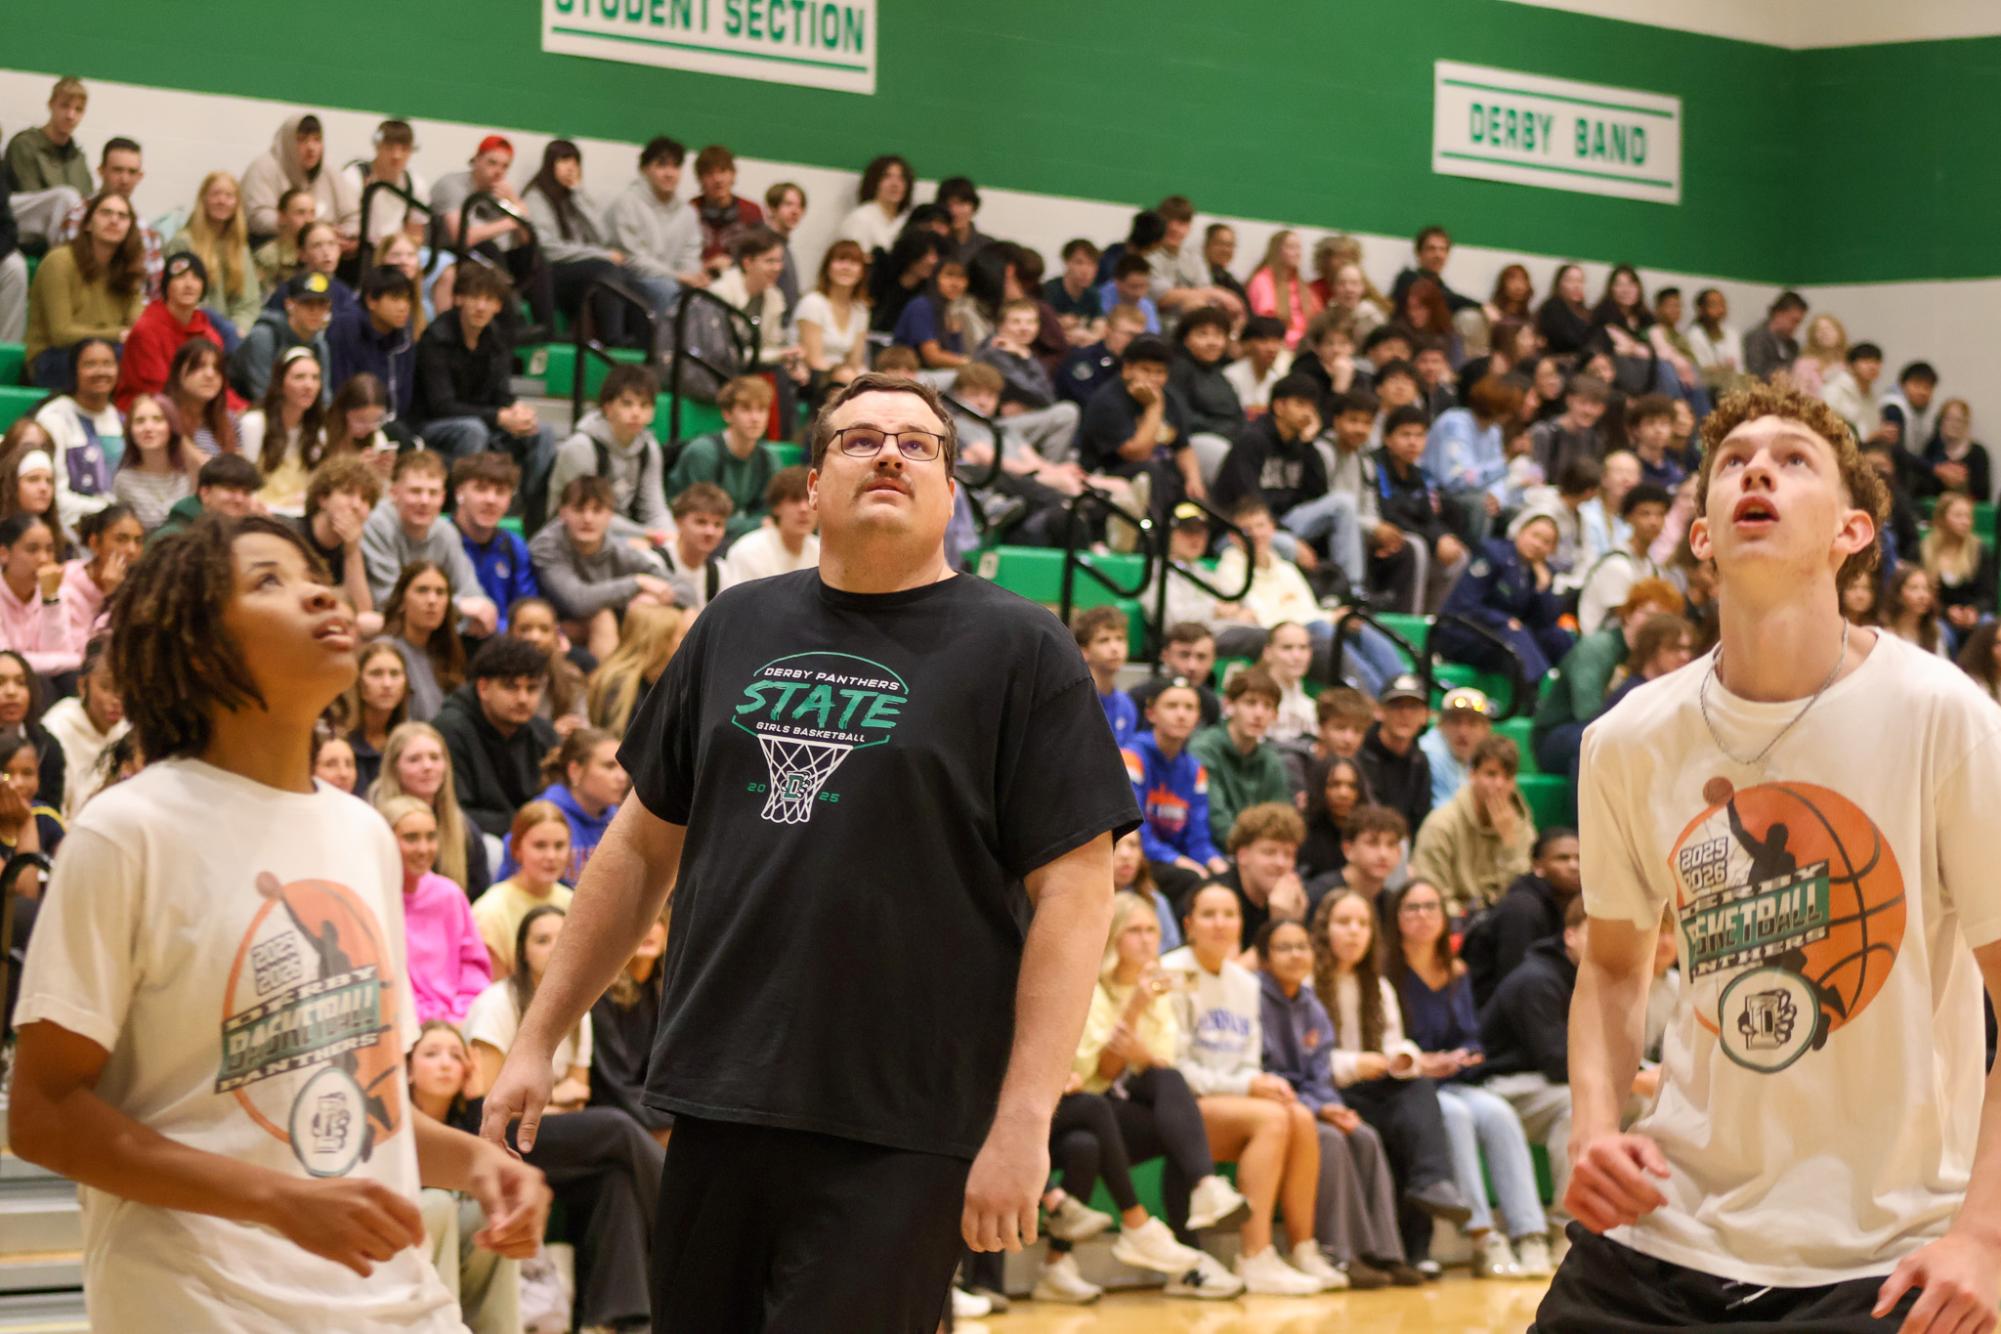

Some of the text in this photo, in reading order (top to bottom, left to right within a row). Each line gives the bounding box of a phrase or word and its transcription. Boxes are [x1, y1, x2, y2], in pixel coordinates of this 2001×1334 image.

[722, 0, 865, 53] SECTION
[1470, 102, 1647, 166] DERBY BAND
[764, 667, 900, 691] DERBY PANTHERS
[735, 679, 908, 730] STATE
[756, 721, 865, 743] GIRLS BASKETBALL
[746, 782, 841, 804] 20 25
[1680, 838, 1728, 871] 2025
[1682, 860, 1728, 893] 2026
[227, 965, 377, 1031] DERBY
[219, 1032, 379, 1090] PANTHERS
